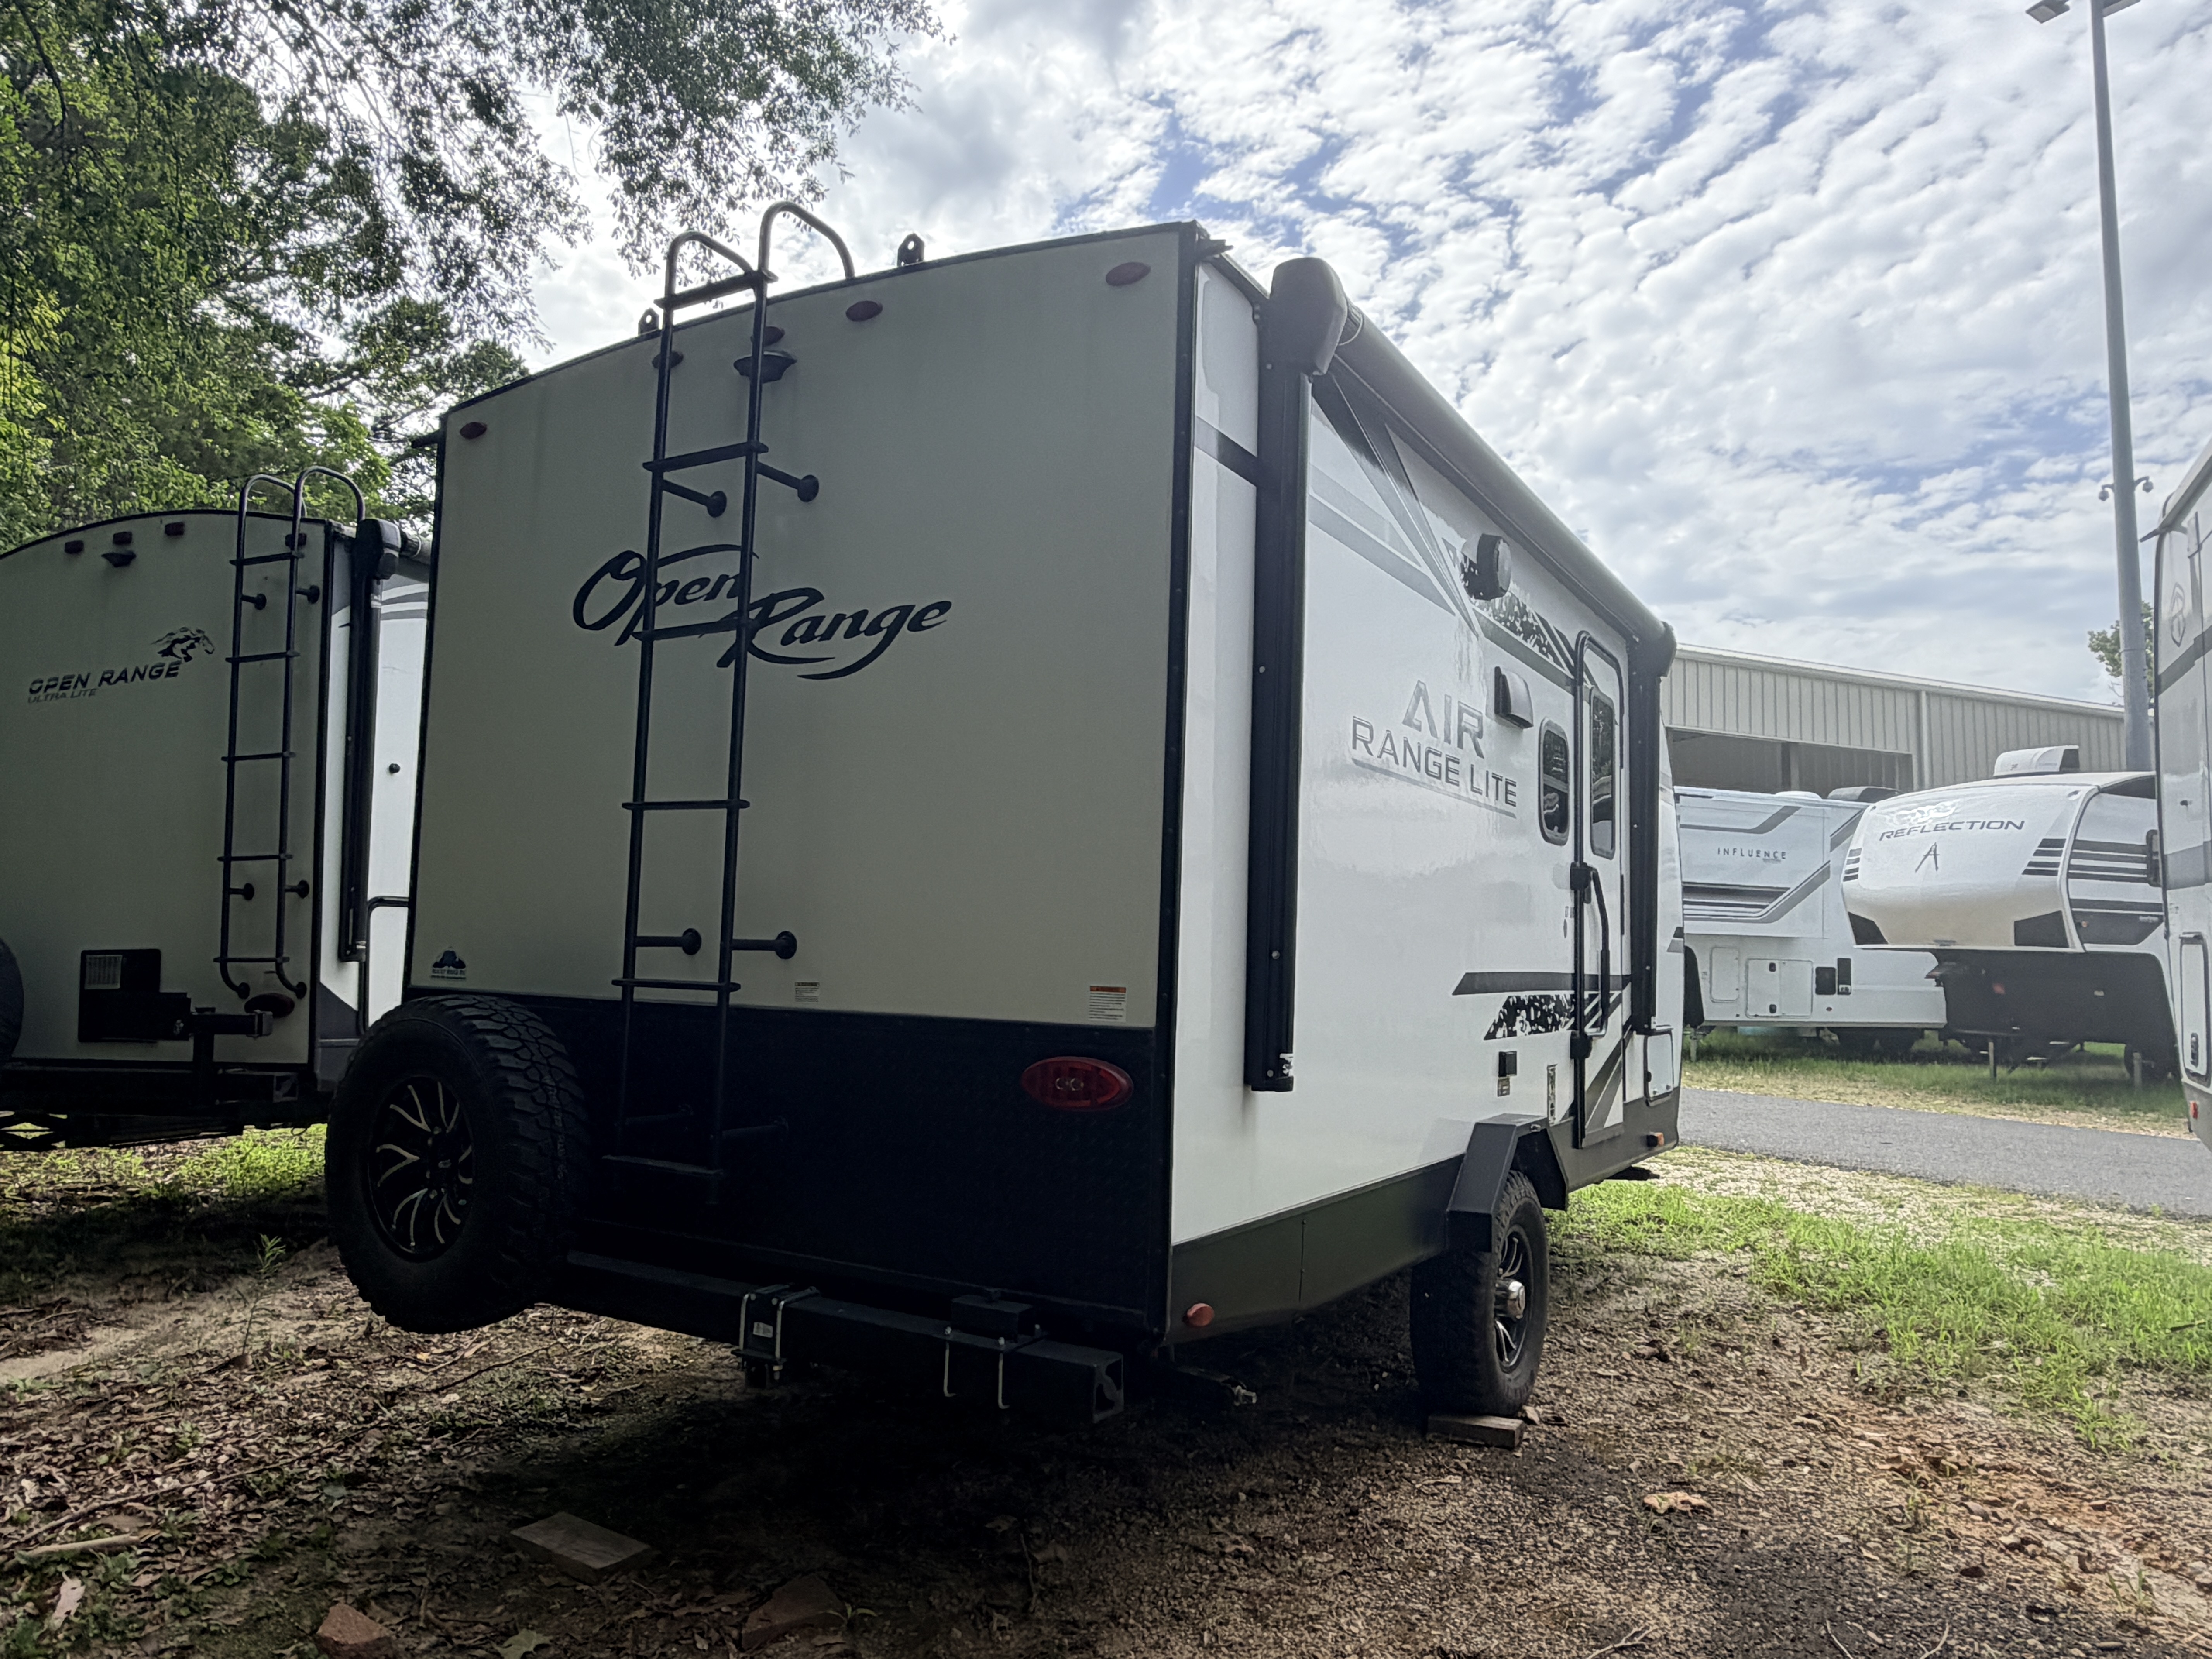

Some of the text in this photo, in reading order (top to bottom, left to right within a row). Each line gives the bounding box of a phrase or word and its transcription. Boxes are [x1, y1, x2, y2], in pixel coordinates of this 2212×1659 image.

[572, 544, 952, 680] Open Range
[29, 660, 182, 695] OPEN RANGE
[27, 688, 97, 703] ULTRA LITE
[1402, 679, 1485, 759] AIR
[1352, 716, 1517, 807] RANGE LITE
[1879, 820, 2025, 842] REFLECTION
[1717, 847, 1786, 859] INFLUENCE
